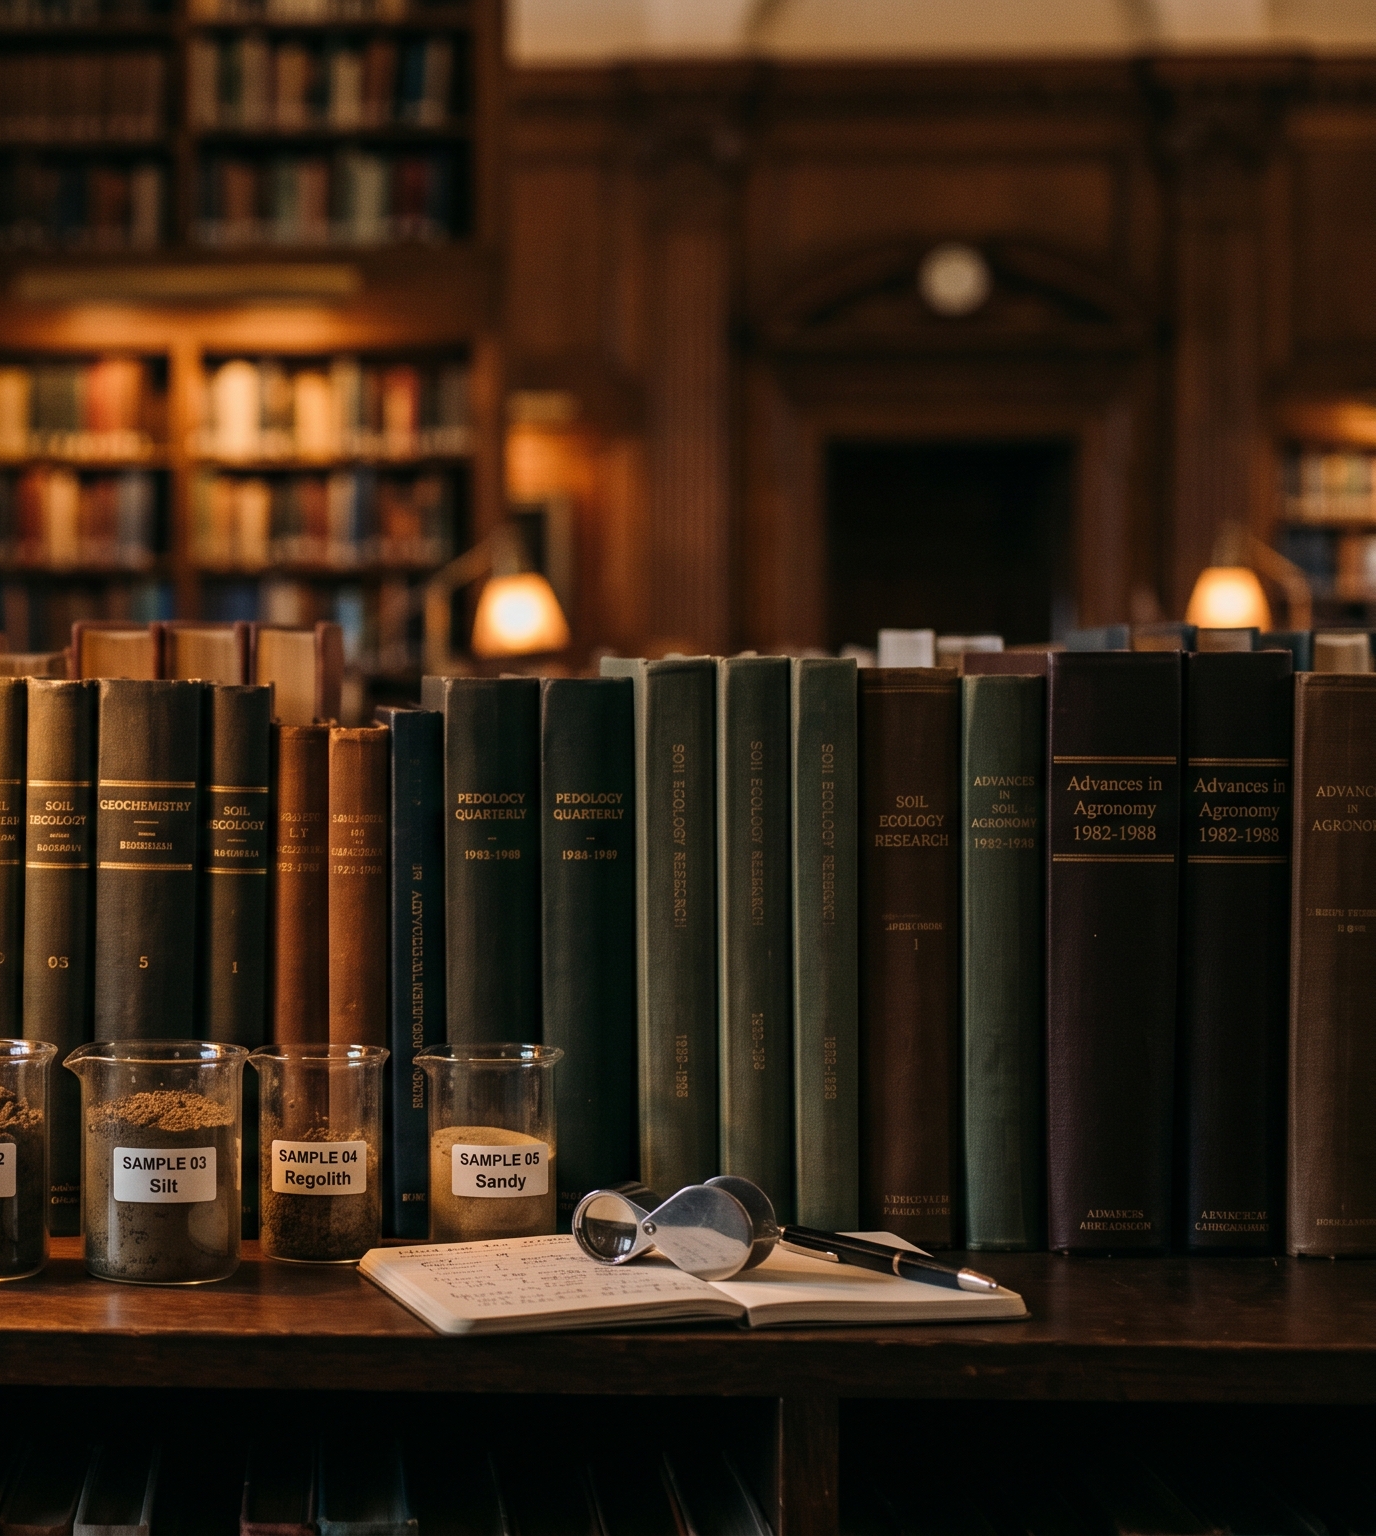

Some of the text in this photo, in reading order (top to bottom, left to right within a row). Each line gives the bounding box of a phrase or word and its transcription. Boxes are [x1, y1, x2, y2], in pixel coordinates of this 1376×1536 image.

[974, 776, 1035, 787] ADVANCES
[1067, 775, 1163, 791] Advances in
[1193, 777, 1286, 793] Advances in
[999, 790, 1010, 799] IN
[1316, 785, 1376, 797] ADVANC
[556, 793, 623, 804] PEDOLOGY
[896, 795, 929, 808] SOIL
[45, 801, 74, 811] SOIL
[100, 800, 191, 812] GEOCHEMISTRY
[224, 806, 250, 816] SOIL
[991, 804, 1018, 814] SOIL
[1073, 800, 1157, 819] Agronomy
[1199, 802, 1280, 821] Agronomy
[1347, 804, 1358, 813] IN
[455, 808, 527, 821] QUARTERLY
[553, 808, 624, 821] QUARTERLY
[879, 815, 944, 827] ECOLOGY
[971, 818, 1037, 828] AGRONOMY
[1312, 819, 1376, 832] AGRONO
[1073, 825, 1157, 841] 1982-1988
[1198, 827, 1279, 843] 1982-1988
[875, 834, 949, 847] RESEARCH
[139, 956, 148, 969] 5
[122, 1156, 207, 1170] SAMPLE 03
[279, 1149, 358, 1164] SAMPLE 04
[460, 1152, 540, 1167] SAMPLE 05
[149, 1178, 178, 1194] Silt
[285, 1170, 351, 1189] Regolith
[475, 1174, 526, 1191] Sandy
